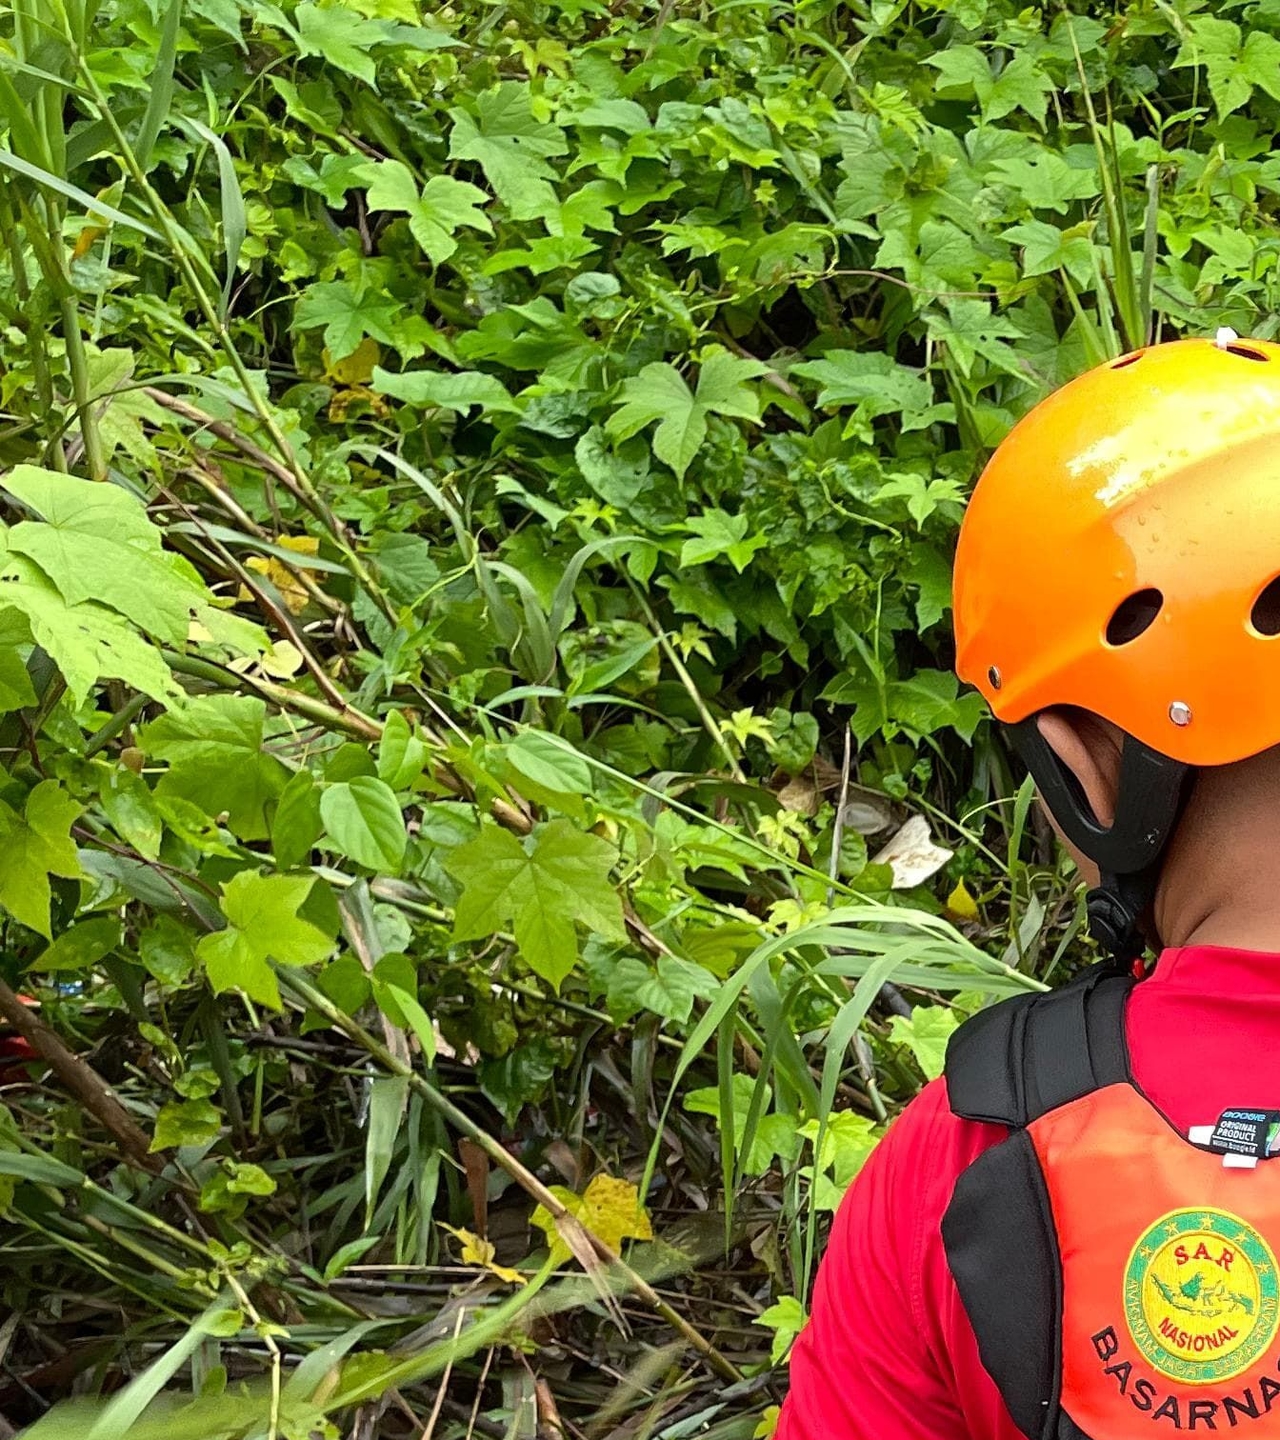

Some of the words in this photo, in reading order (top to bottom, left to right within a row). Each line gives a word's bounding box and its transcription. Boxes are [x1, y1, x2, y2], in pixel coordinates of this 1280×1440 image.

[1220, 1120, 1257, 1133] ORIGINAL
[1216, 1127, 1256, 1142] PRODUCT
[1157, 1316, 1240, 1353] NASIONAL
